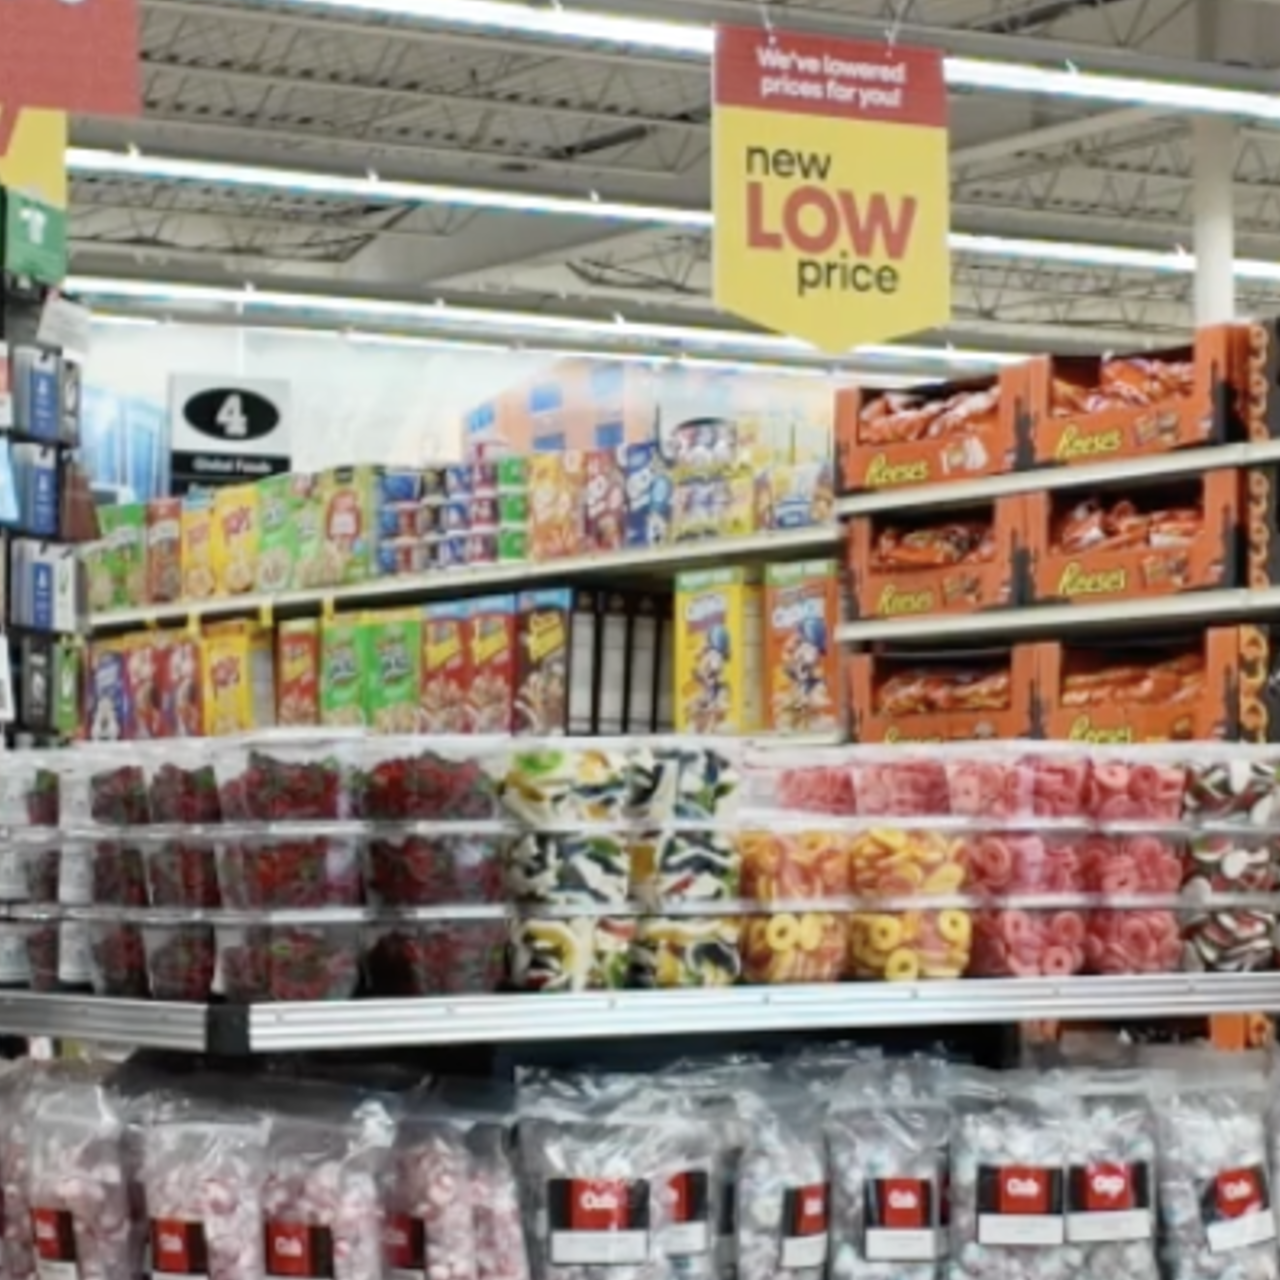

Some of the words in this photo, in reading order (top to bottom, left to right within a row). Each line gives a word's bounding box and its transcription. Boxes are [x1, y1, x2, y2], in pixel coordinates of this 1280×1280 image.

[756, 46, 819, 73] We've
[823, 55, 907, 84] lowered
[760, 74, 823, 100] prices
[826, 80, 856, 102] for
[859, 86, 902, 109] you!
[746, 145, 831, 181] new
[746, 181, 917, 260] LOW
[798, 250, 900, 297] price
[216, 394, 248, 437] 4
